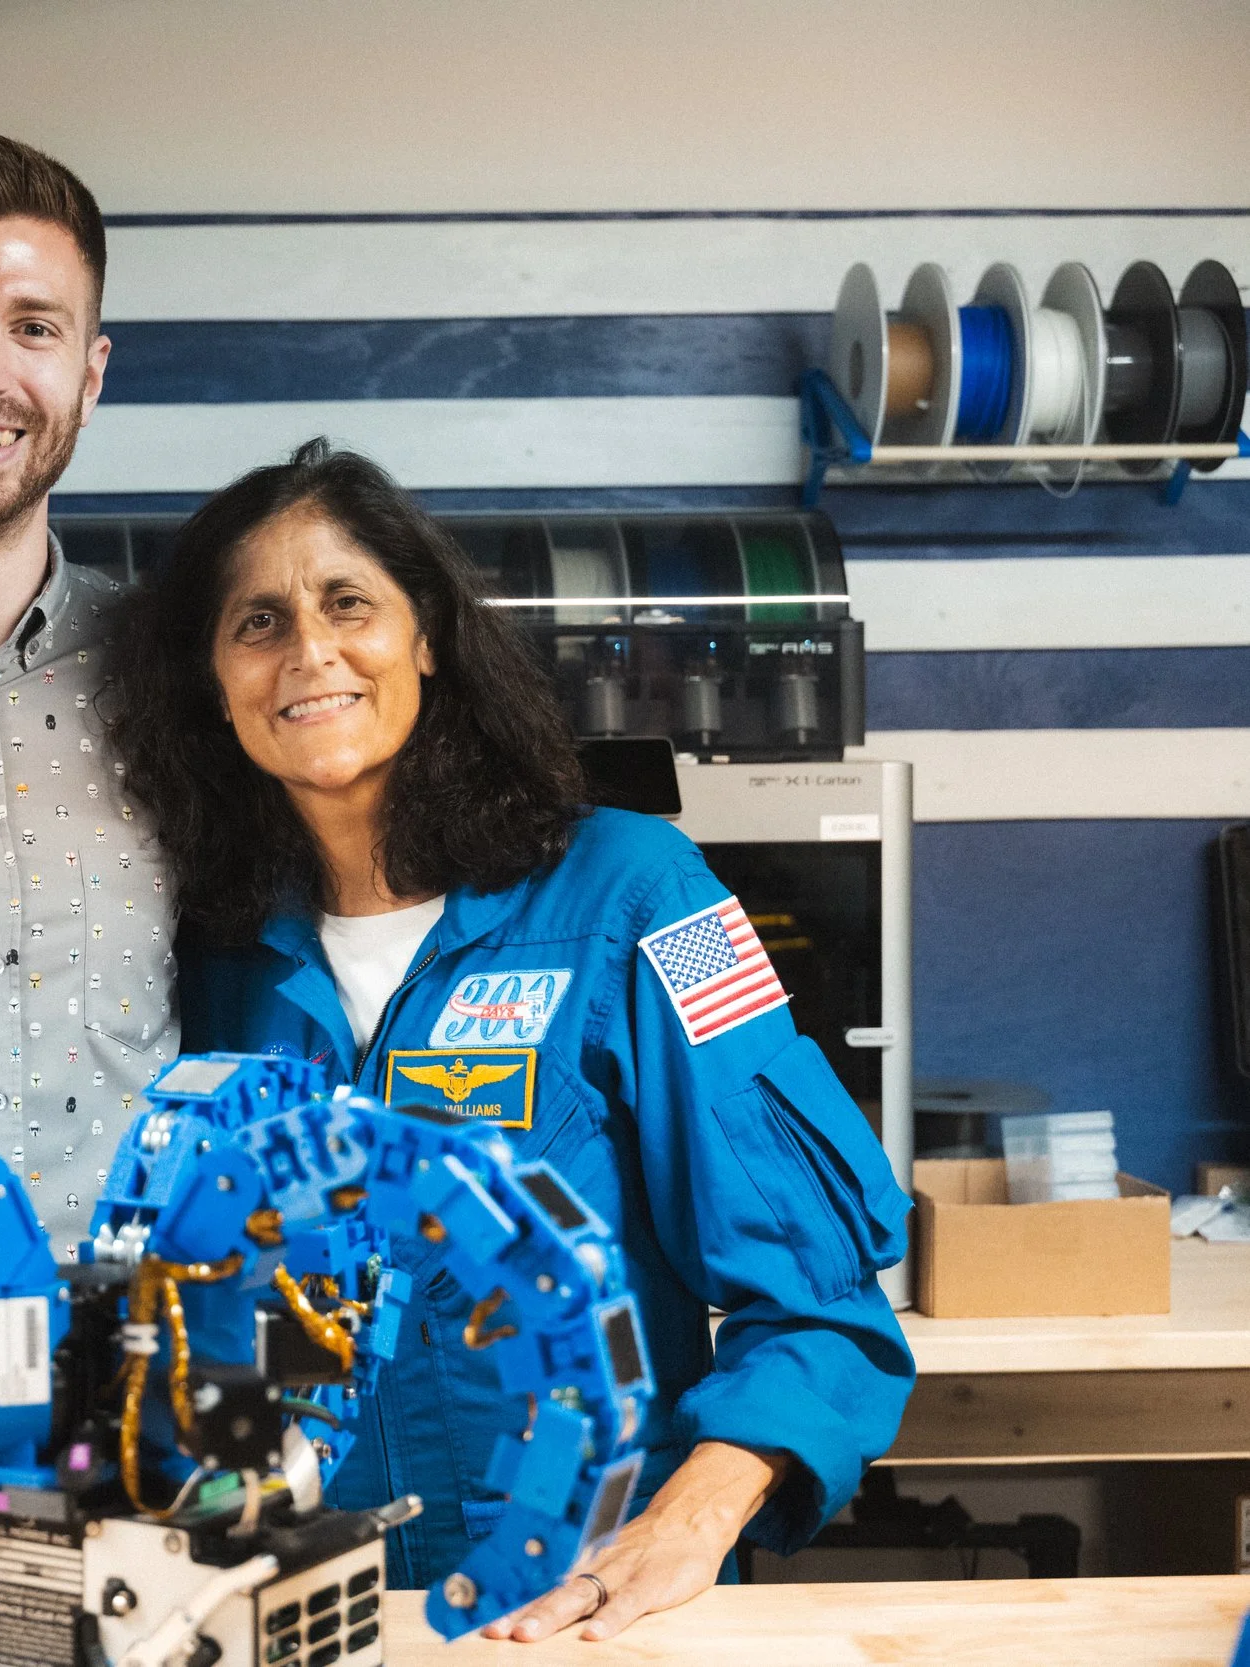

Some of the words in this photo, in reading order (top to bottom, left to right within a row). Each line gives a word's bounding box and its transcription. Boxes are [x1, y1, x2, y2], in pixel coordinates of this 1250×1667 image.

[782, 642, 834, 654] AMS
[815, 775, 862, 786] Carbon
[480, 1005, 516, 1018] DAYS
